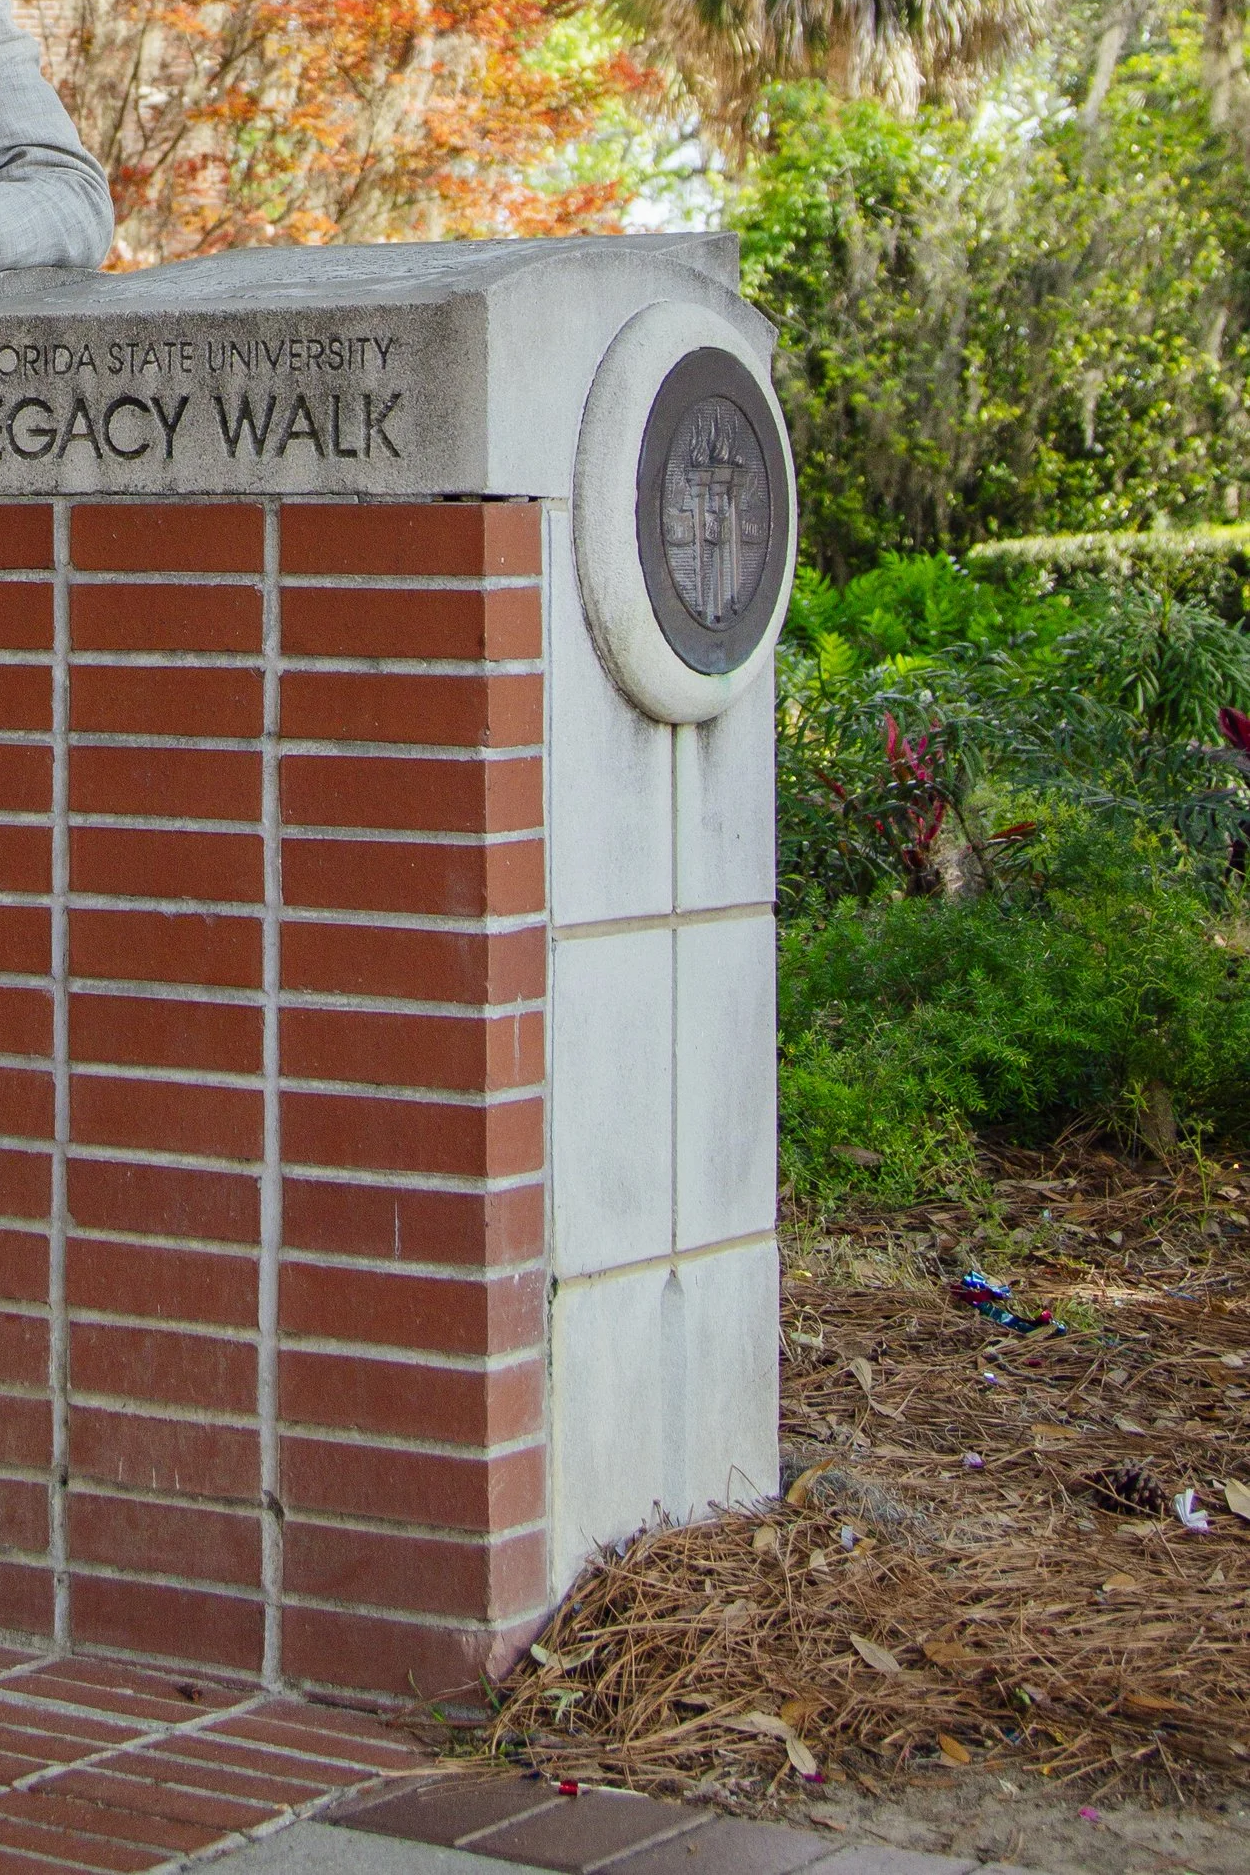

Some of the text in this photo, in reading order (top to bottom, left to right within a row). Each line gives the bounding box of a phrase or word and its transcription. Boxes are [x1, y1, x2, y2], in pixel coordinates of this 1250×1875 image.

[106, 340, 193, 375] STATE
[206, 337, 394, 373] UNIVERSITY
[211, 392, 402, 459] WALK
